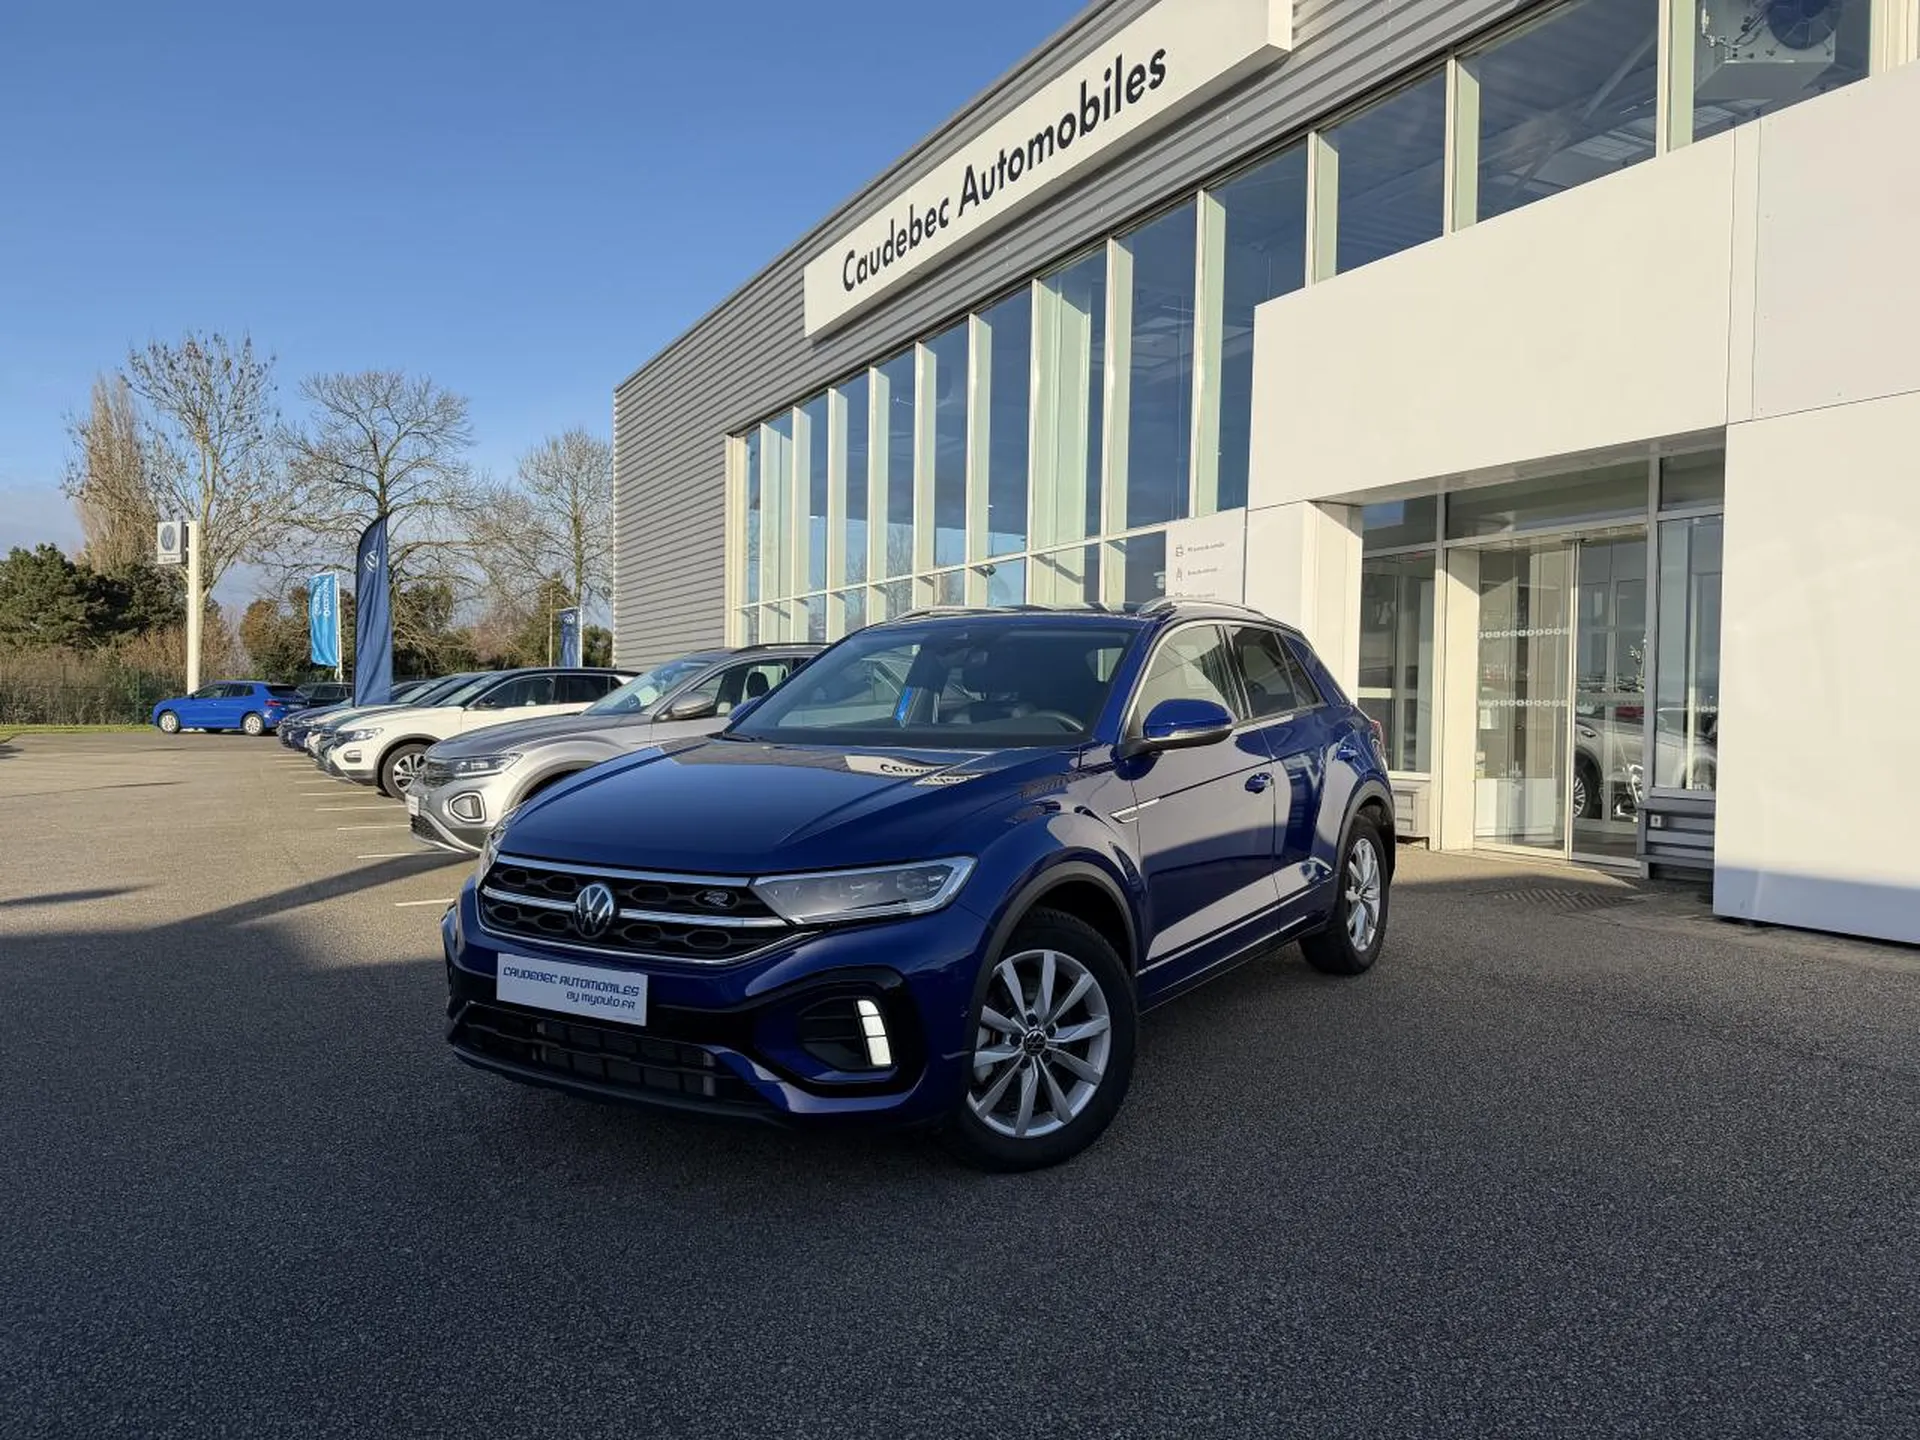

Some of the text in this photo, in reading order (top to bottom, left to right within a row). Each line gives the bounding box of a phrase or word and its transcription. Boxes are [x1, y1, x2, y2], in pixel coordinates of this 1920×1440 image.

[842, 48, 1167, 292] Caudebec Automobiles
[503, 966, 640, 997] CAUDEBEC AUTOMOBILES
